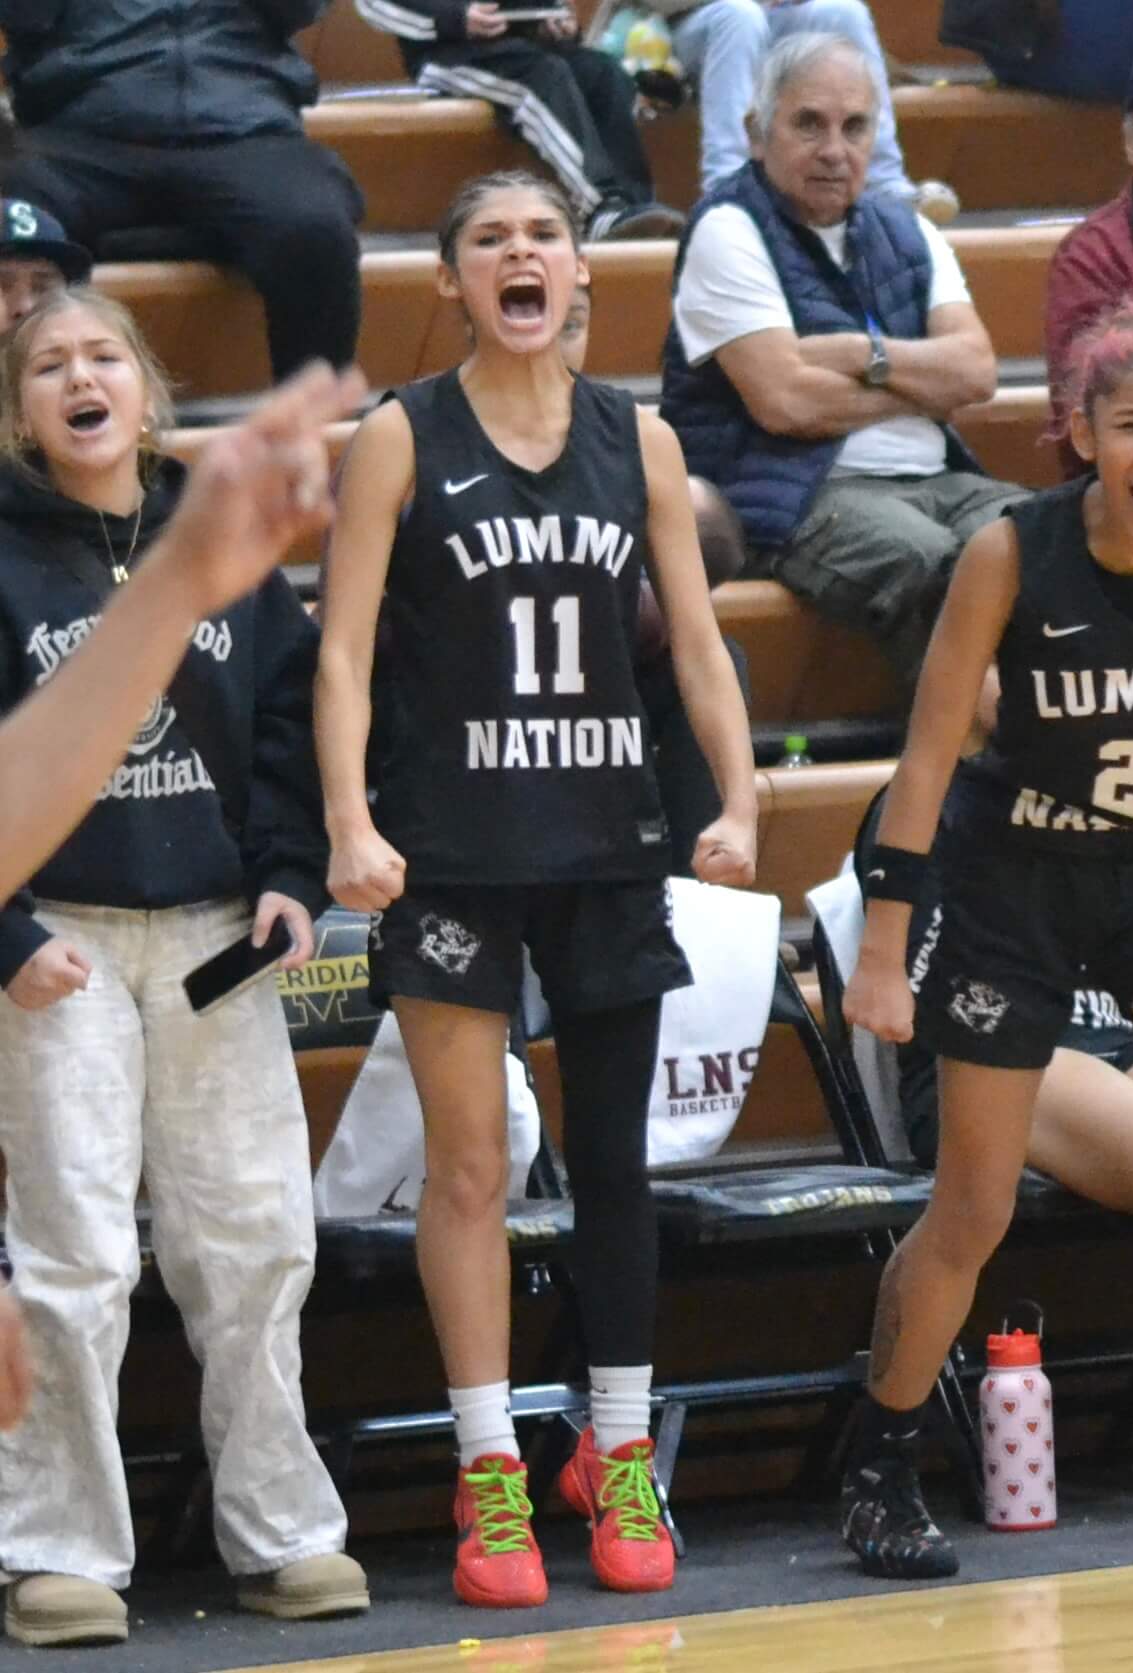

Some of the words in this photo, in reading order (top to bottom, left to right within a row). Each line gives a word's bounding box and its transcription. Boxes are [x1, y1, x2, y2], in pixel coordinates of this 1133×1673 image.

[9, 202, 38, 237] S
[445, 513, 636, 580] LUMMI
[508, 595, 585, 695] 11
[465, 716, 644, 770] NATION
